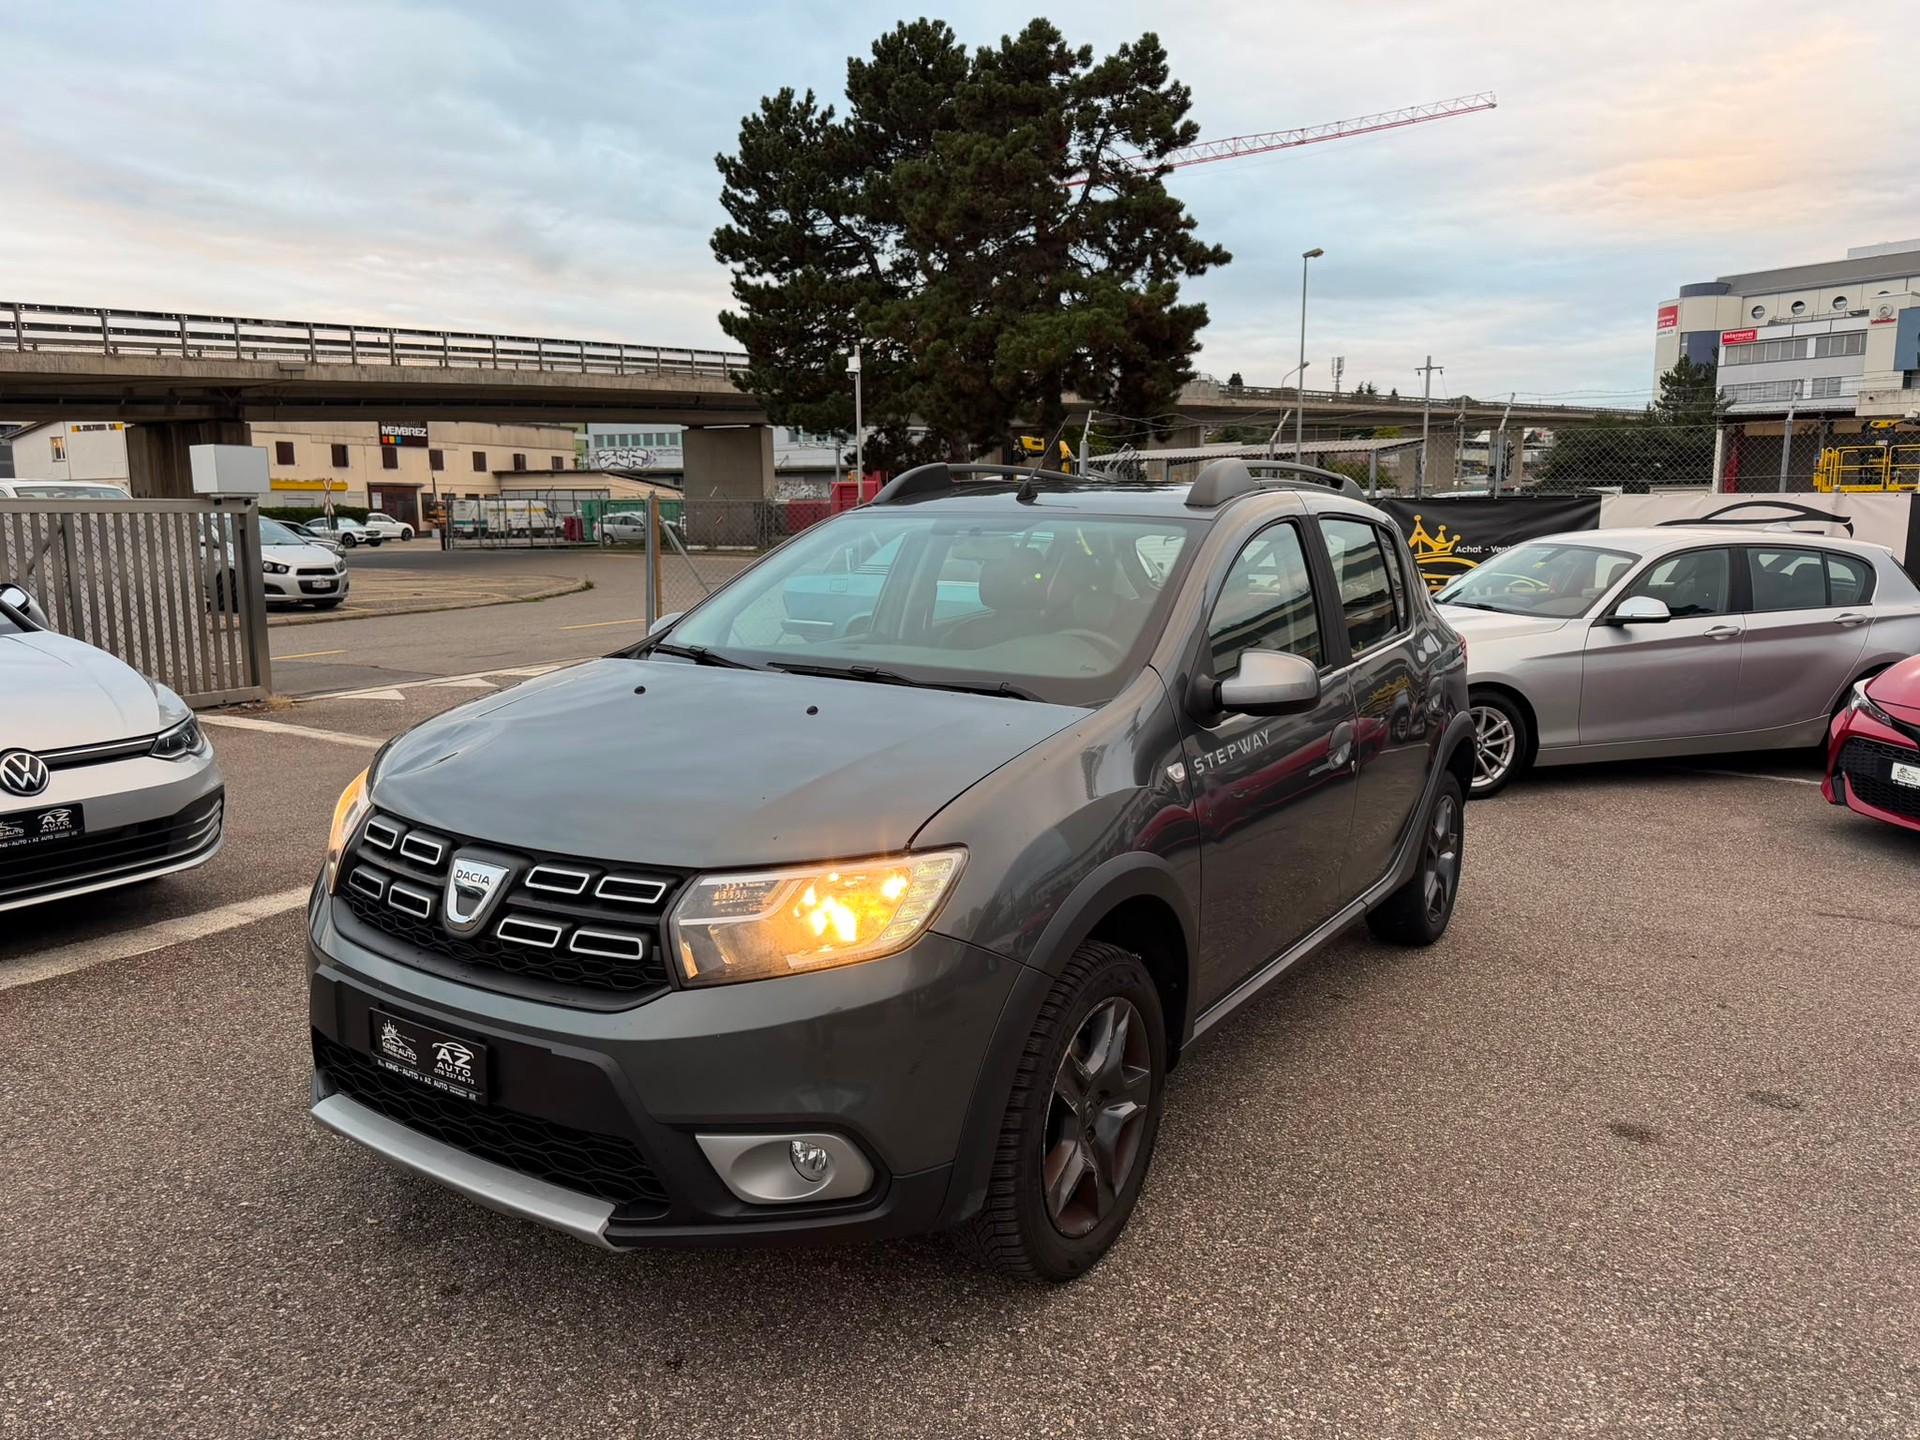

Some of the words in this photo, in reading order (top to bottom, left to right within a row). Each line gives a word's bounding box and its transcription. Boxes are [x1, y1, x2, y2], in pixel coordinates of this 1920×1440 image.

[381, 425, 427, 437] MEMBREZ
[1455, 545, 1482, 554] Achat
[1193, 729, 1270, 775] STEPWAY
[42, 813, 70, 824] AZ
[42, 821, 70, 829] AUTO
[456, 869, 490, 886] DACIA
[436, 1047, 471, 1070] AZ
[434, 1067, 445, 1076] 076
[446, 1071, 457, 1079] 227
[437, 1061, 471, 1077] AUTO
[402, 1068, 418, 1080] AUTO
[433, 1080, 448, 1091] AUTO
